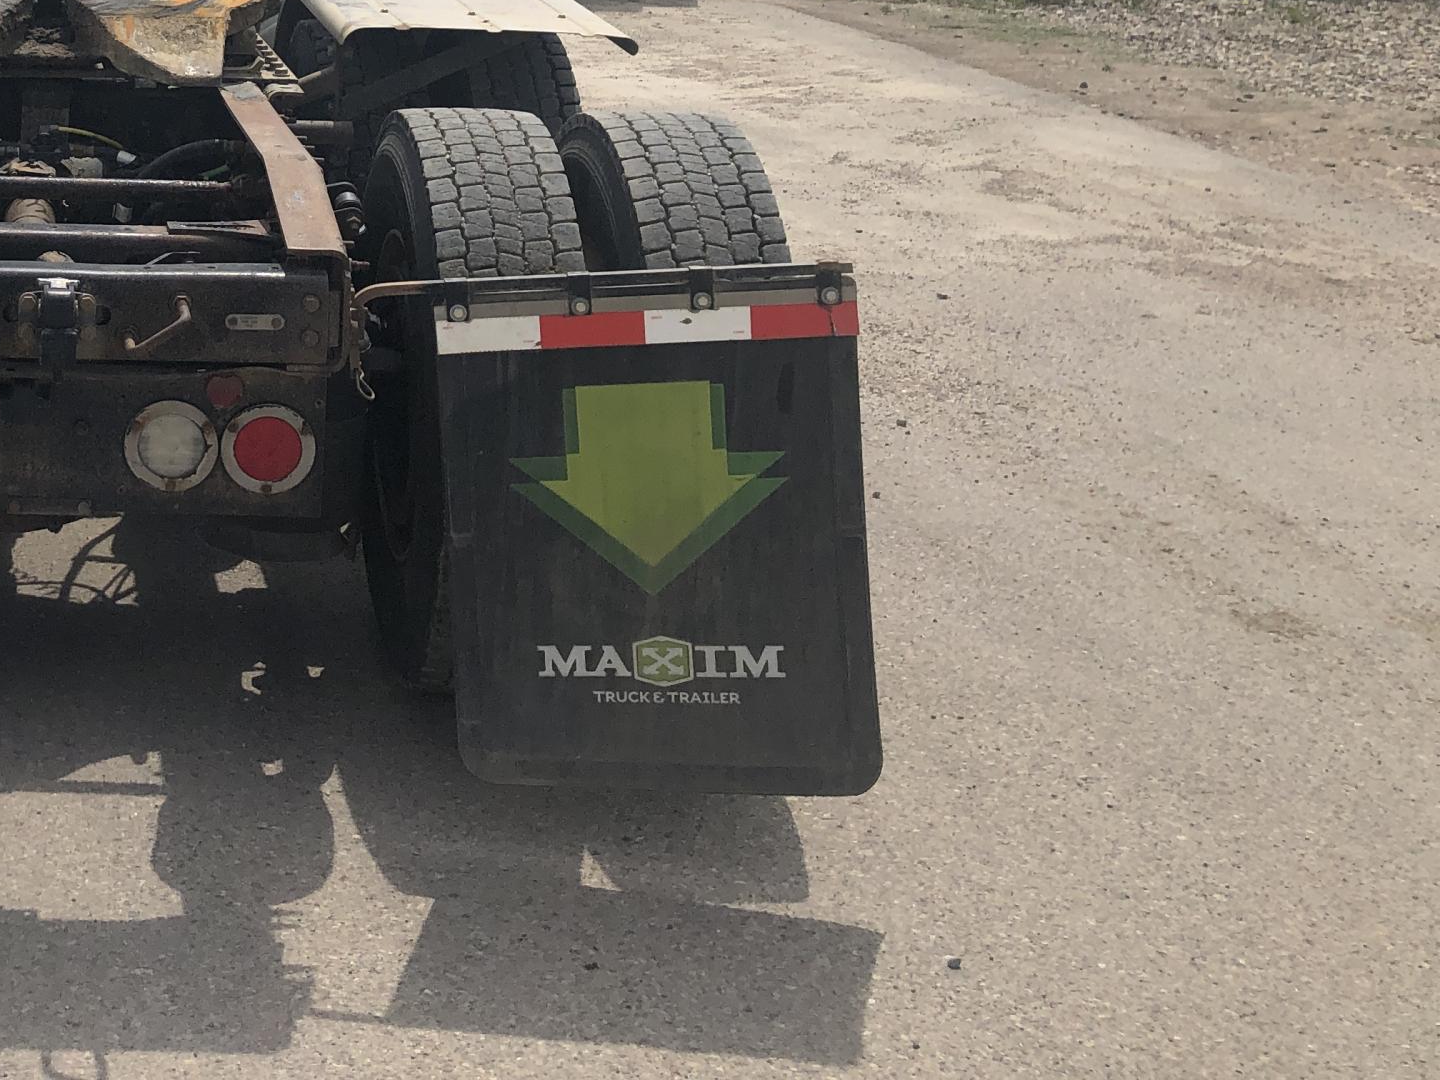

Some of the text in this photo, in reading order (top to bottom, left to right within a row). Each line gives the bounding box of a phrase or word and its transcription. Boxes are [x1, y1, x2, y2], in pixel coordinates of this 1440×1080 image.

[537, 636, 786, 687] MAXIM
[593, 690, 649, 704] TRUCK
[667, 692, 740, 705] TRAILER
